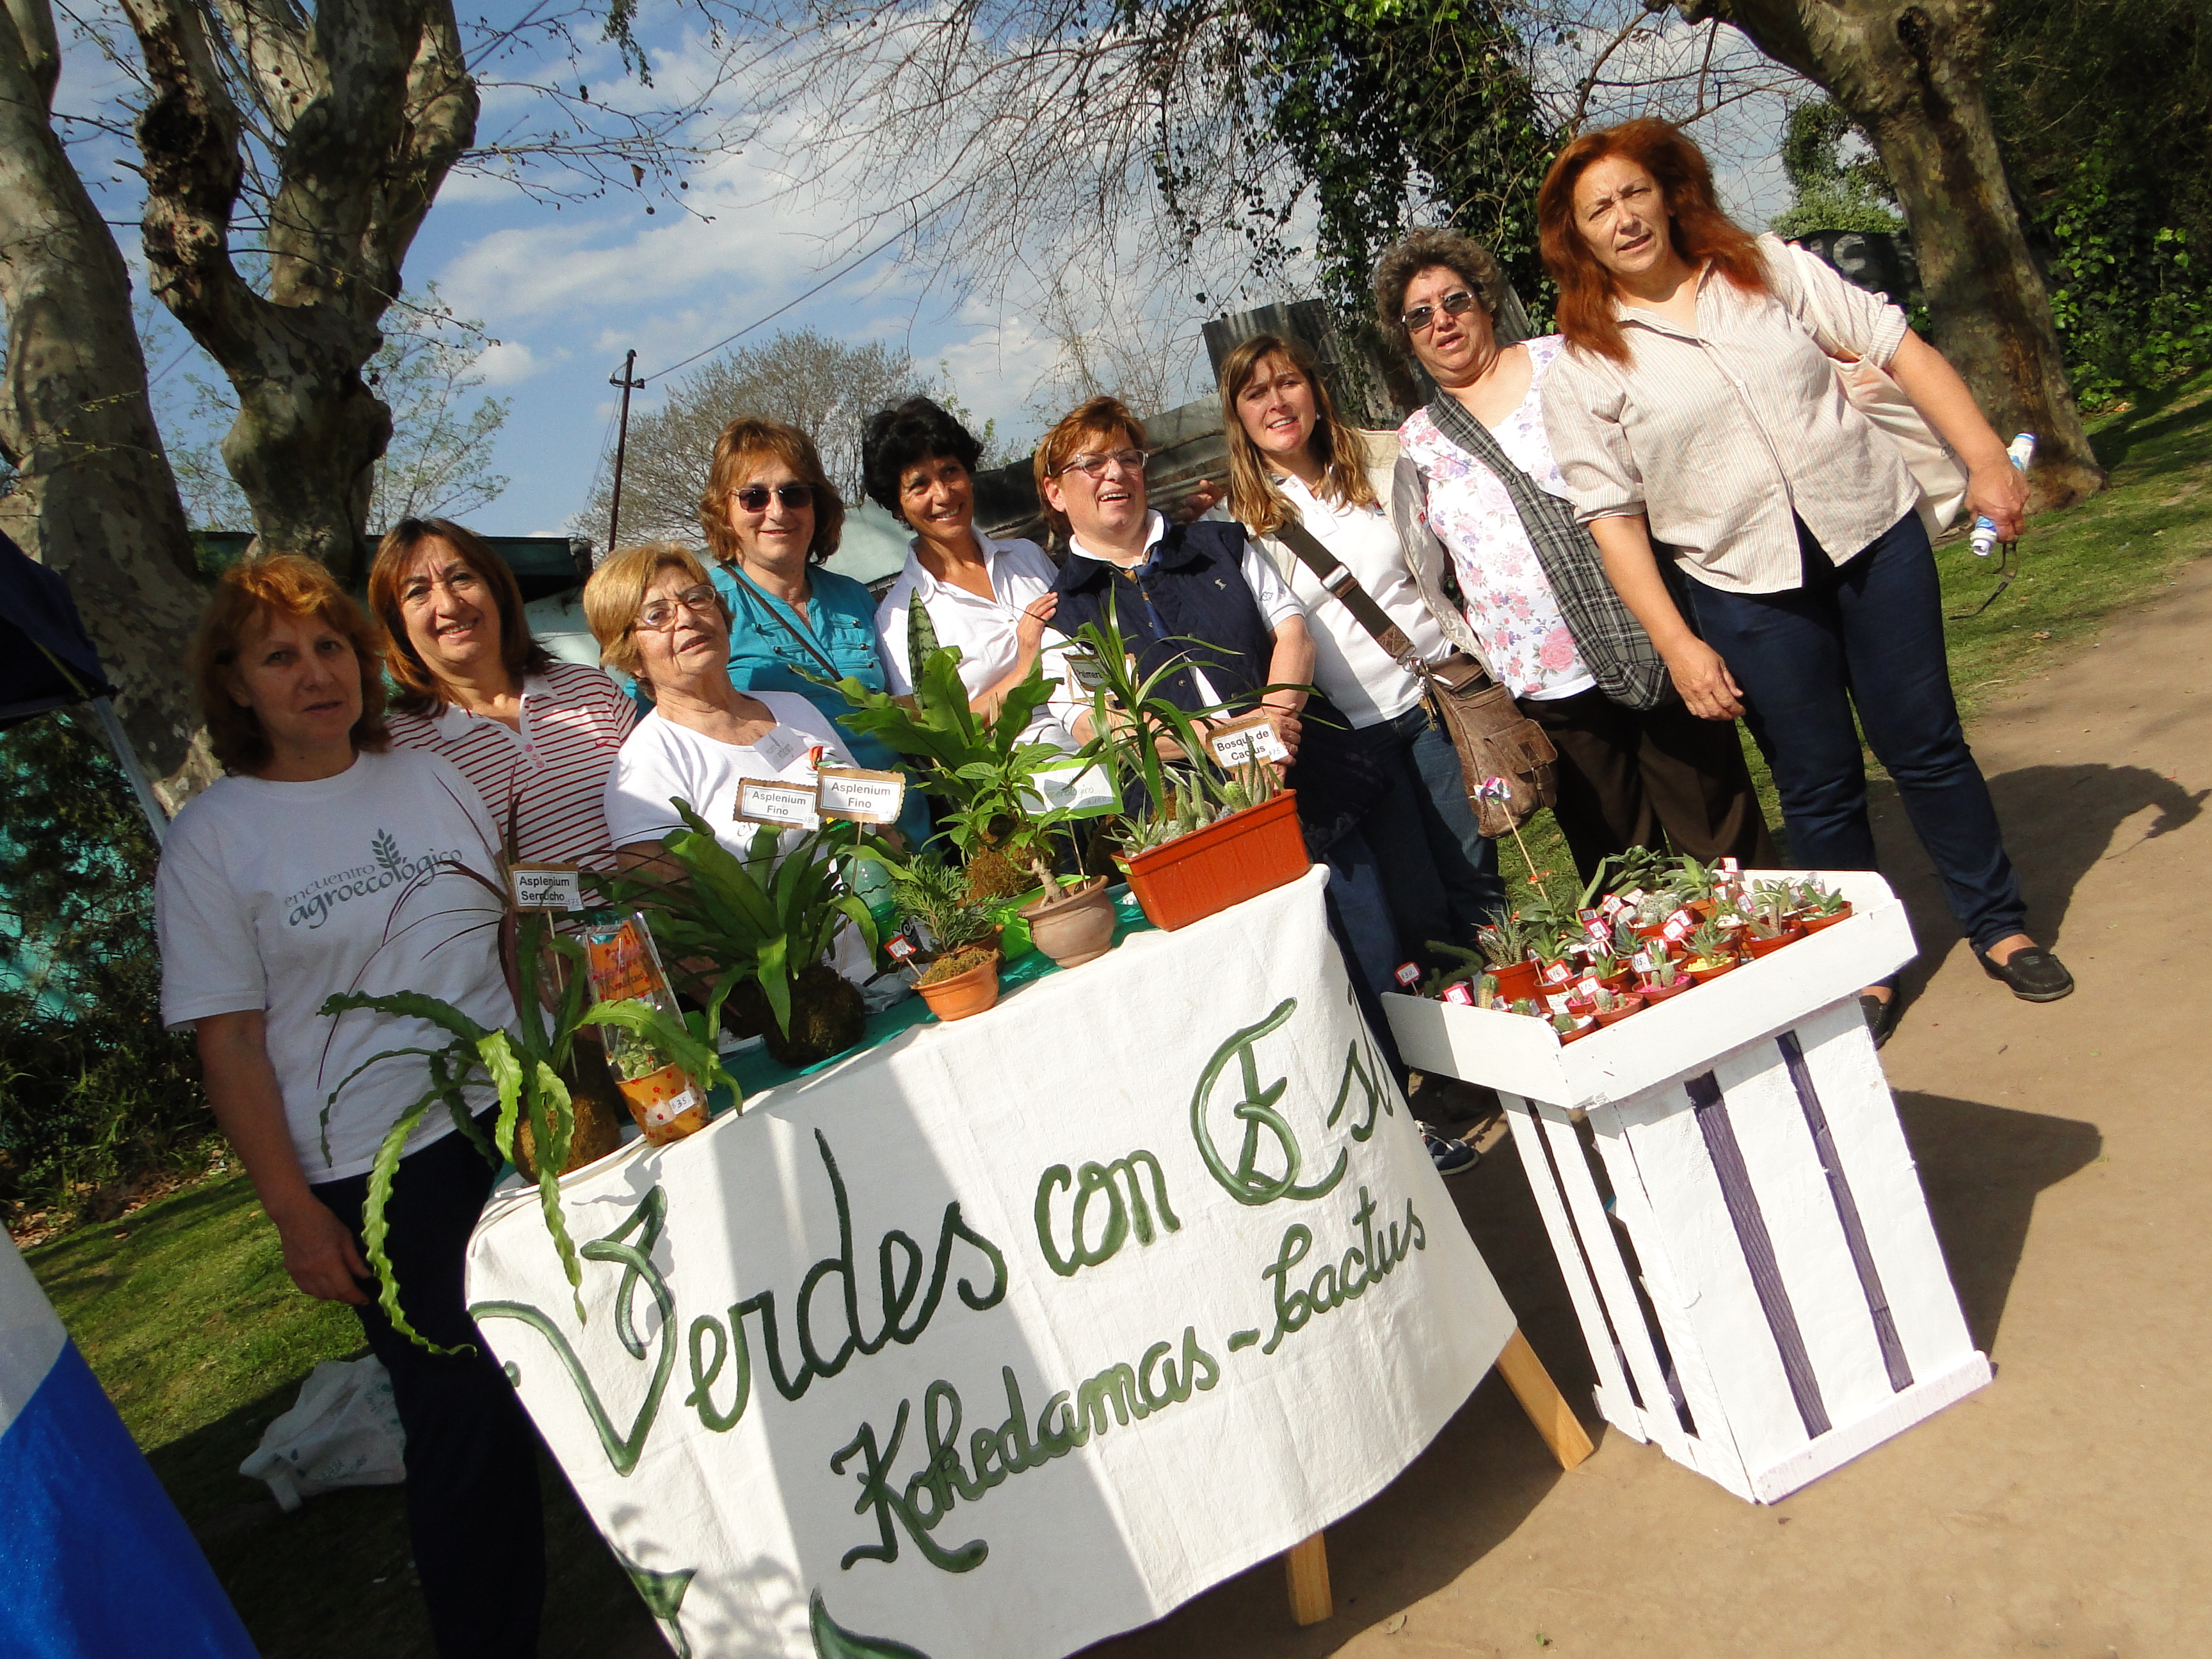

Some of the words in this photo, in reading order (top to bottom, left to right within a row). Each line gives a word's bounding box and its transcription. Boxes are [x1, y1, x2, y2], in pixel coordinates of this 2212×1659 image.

[1217, 735, 1254, 751] Bosque
[1256, 730, 1269, 740] de
[1231, 745, 1266, 760] Cacus
[831, 781, 891, 796] Asplenium
[752, 791, 806, 806] Asplenium
[847, 797, 872, 808] Fino
[767, 805, 789, 816] Fino
[285, 864, 376, 908] encuentro
[519, 876, 570, 888] Asplenium
[521, 890, 565, 901] Serrucho
[469, 1127, 1007, 1478] Verdes
[1034, 1150, 1182, 1276] con
